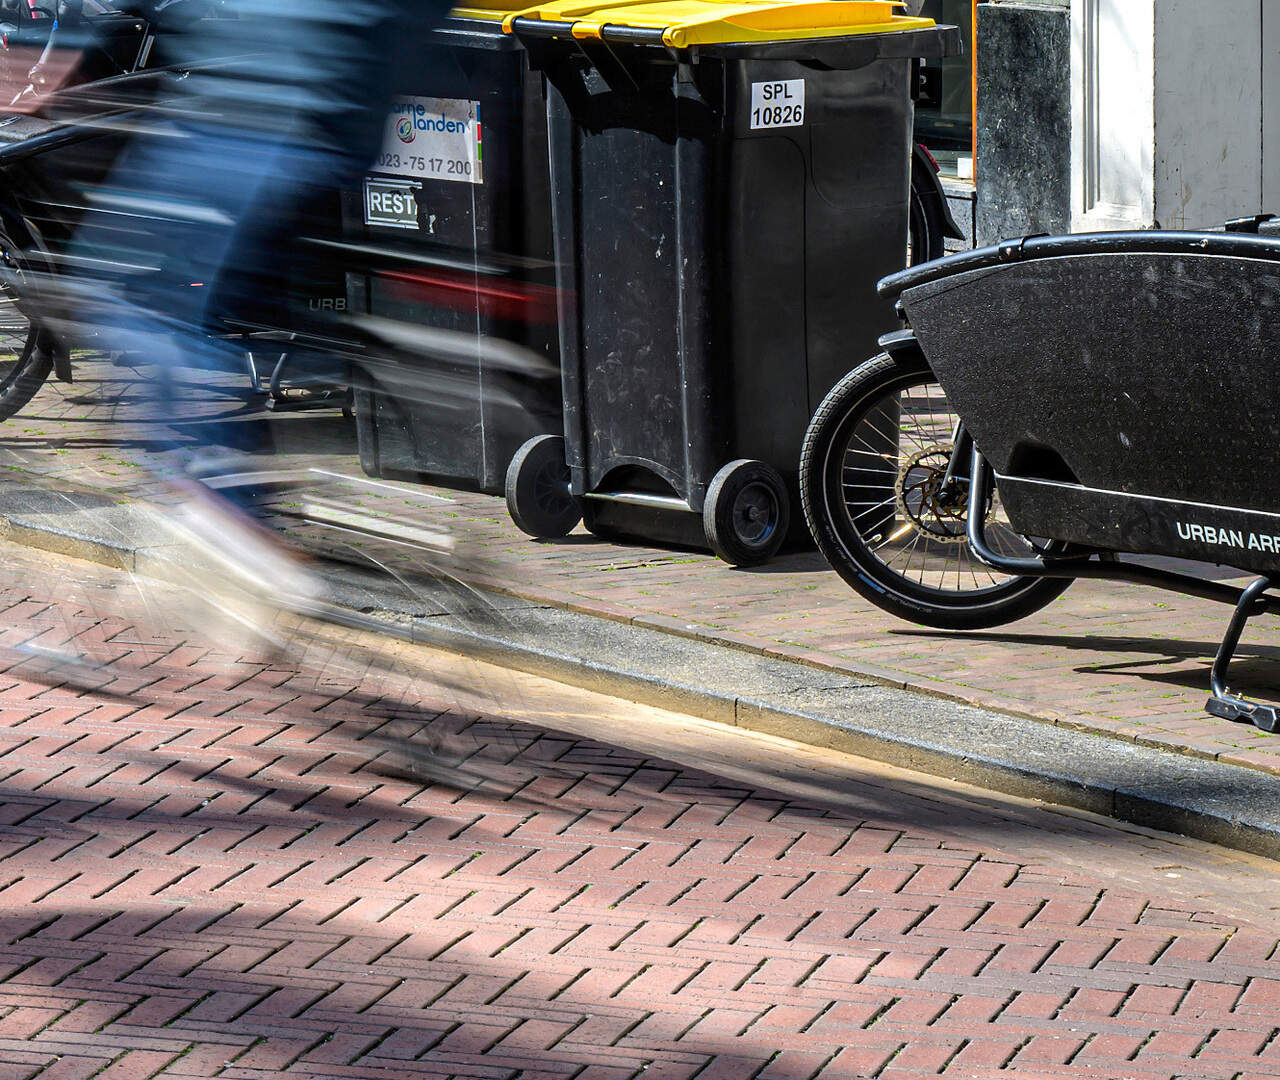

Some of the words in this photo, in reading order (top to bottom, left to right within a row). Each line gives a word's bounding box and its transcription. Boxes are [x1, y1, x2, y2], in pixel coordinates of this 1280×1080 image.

[762, 82, 793, 101] SPL
[753, 104, 803, 126] 10826
[370, 191, 418, 216] REST
[308, 297, 346, 312] URB
[1176, 521, 1245, 549] URBAN
